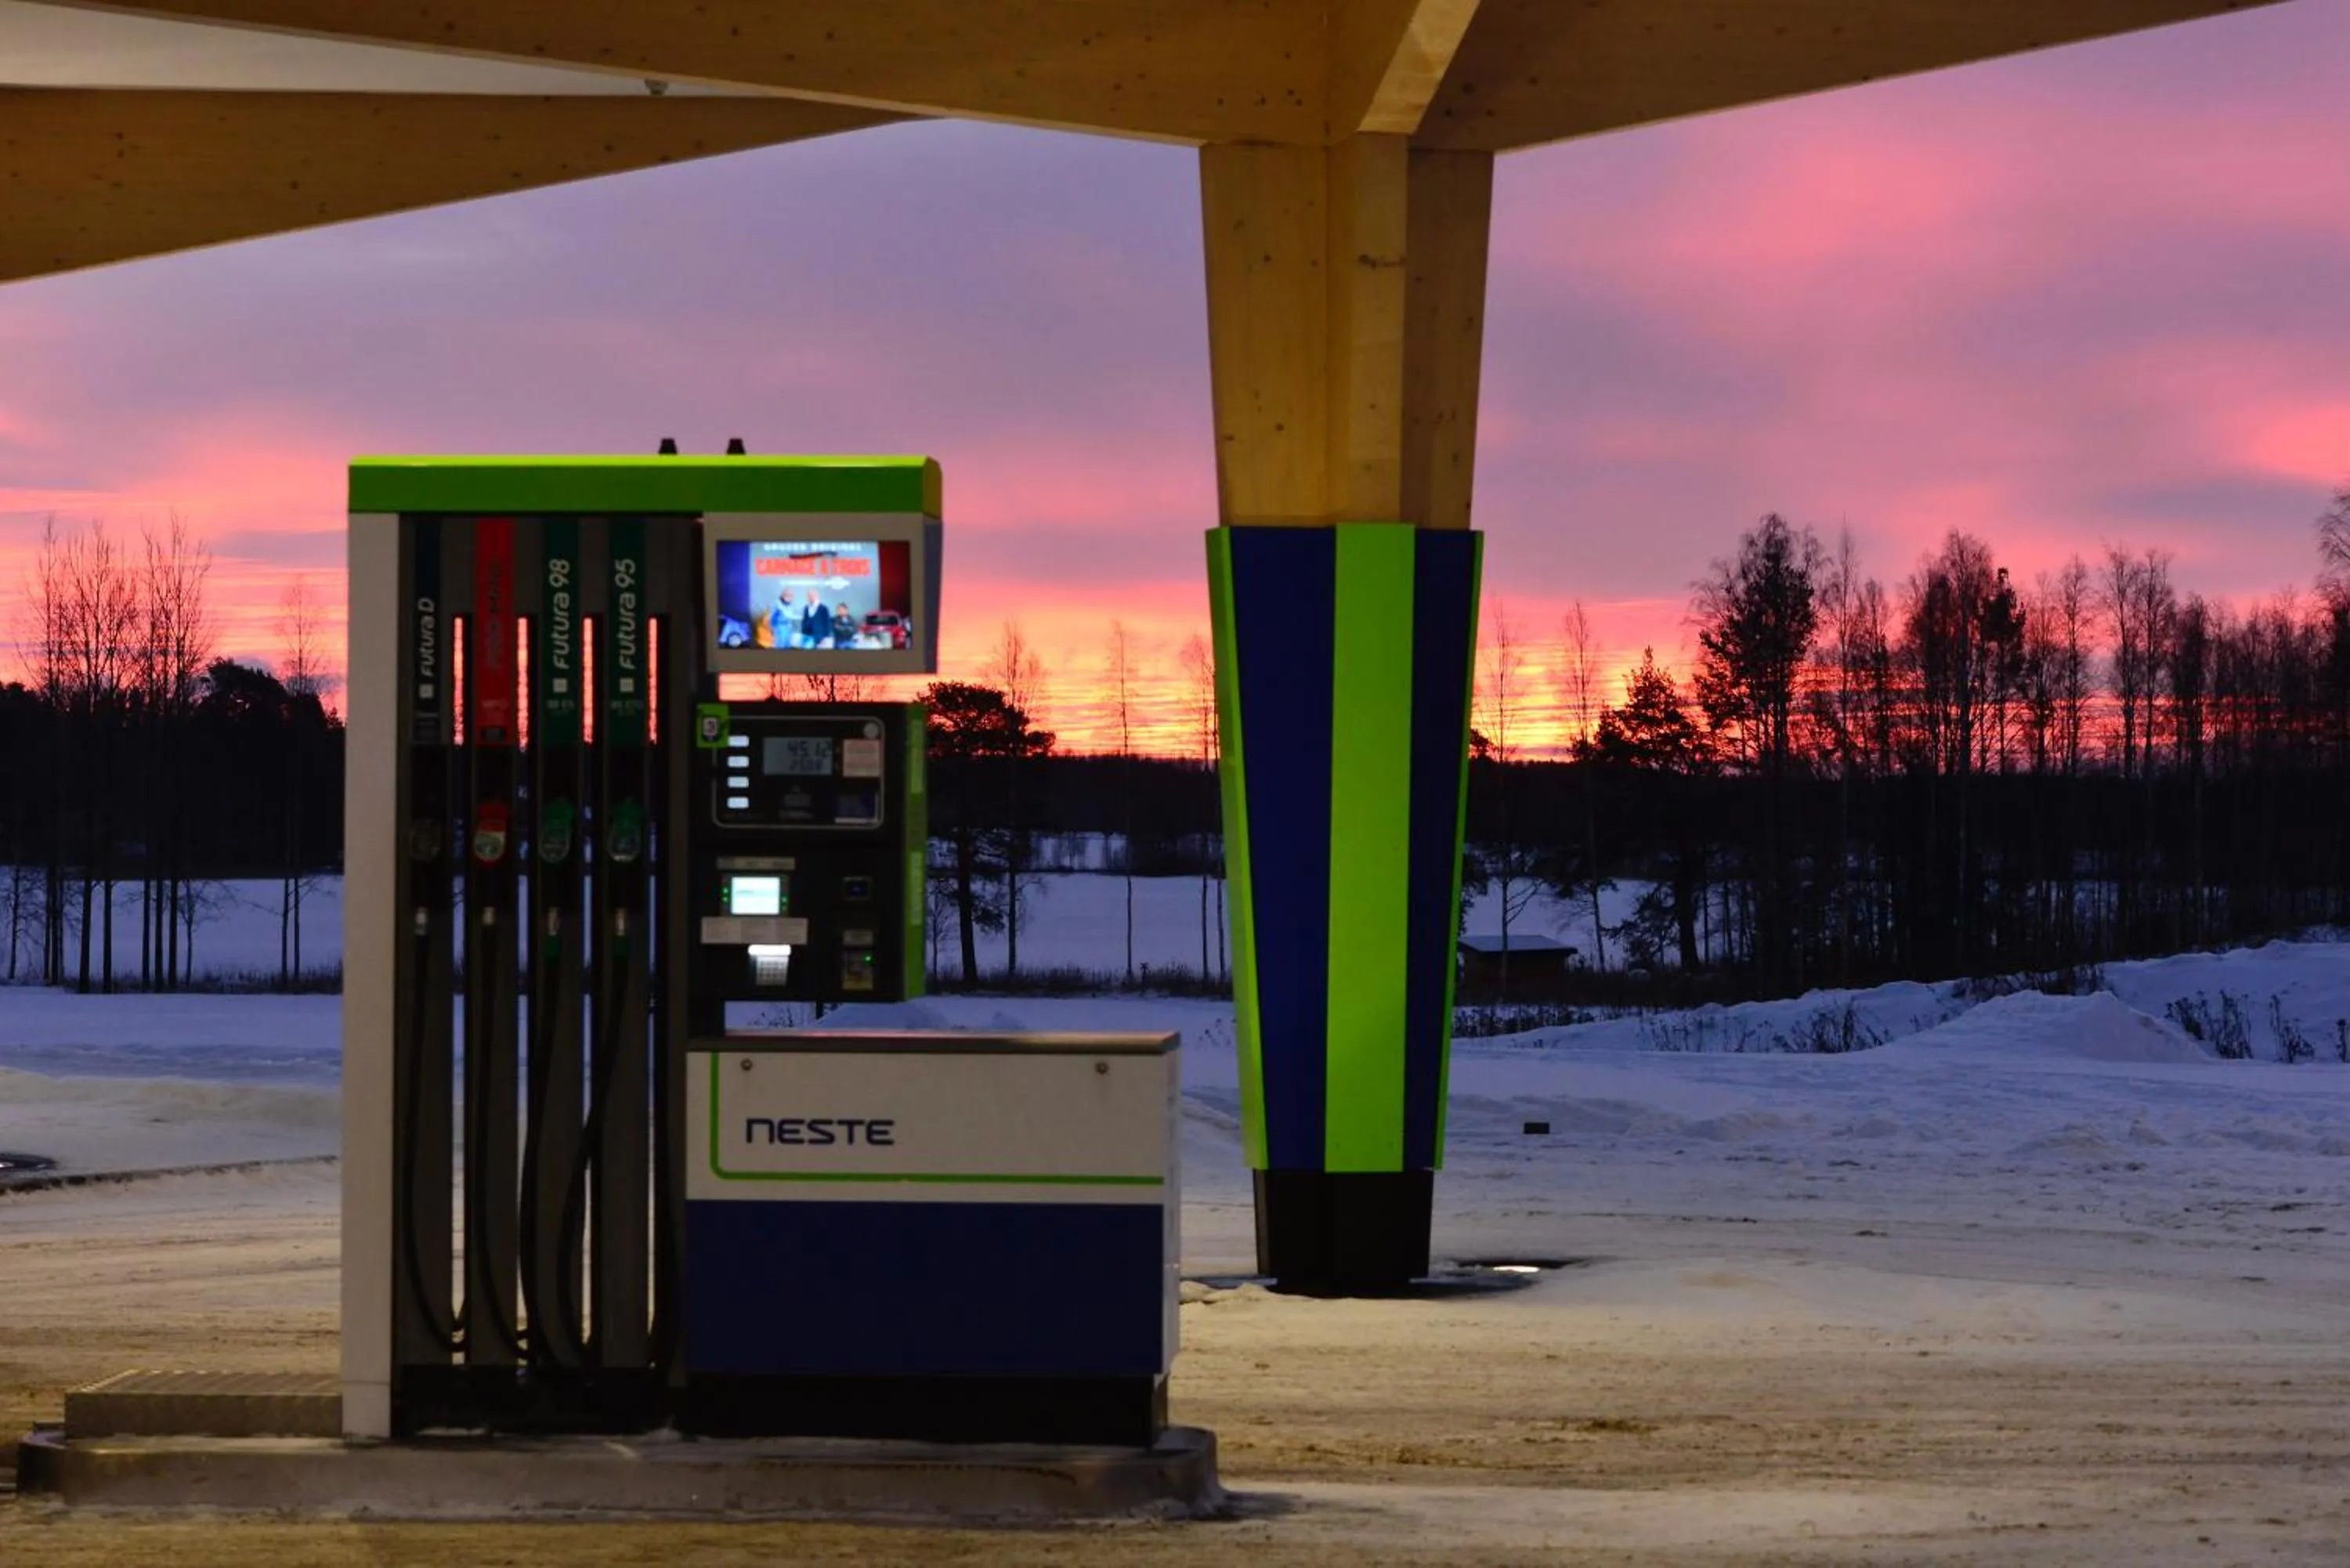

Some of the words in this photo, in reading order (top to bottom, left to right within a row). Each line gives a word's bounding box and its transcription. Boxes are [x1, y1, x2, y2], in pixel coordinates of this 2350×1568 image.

[548, 558, 571, 588] 98
[613, 558, 636, 588] 95
[418, 596, 436, 613] D
[746, 1118, 895, 1145] NESTE
